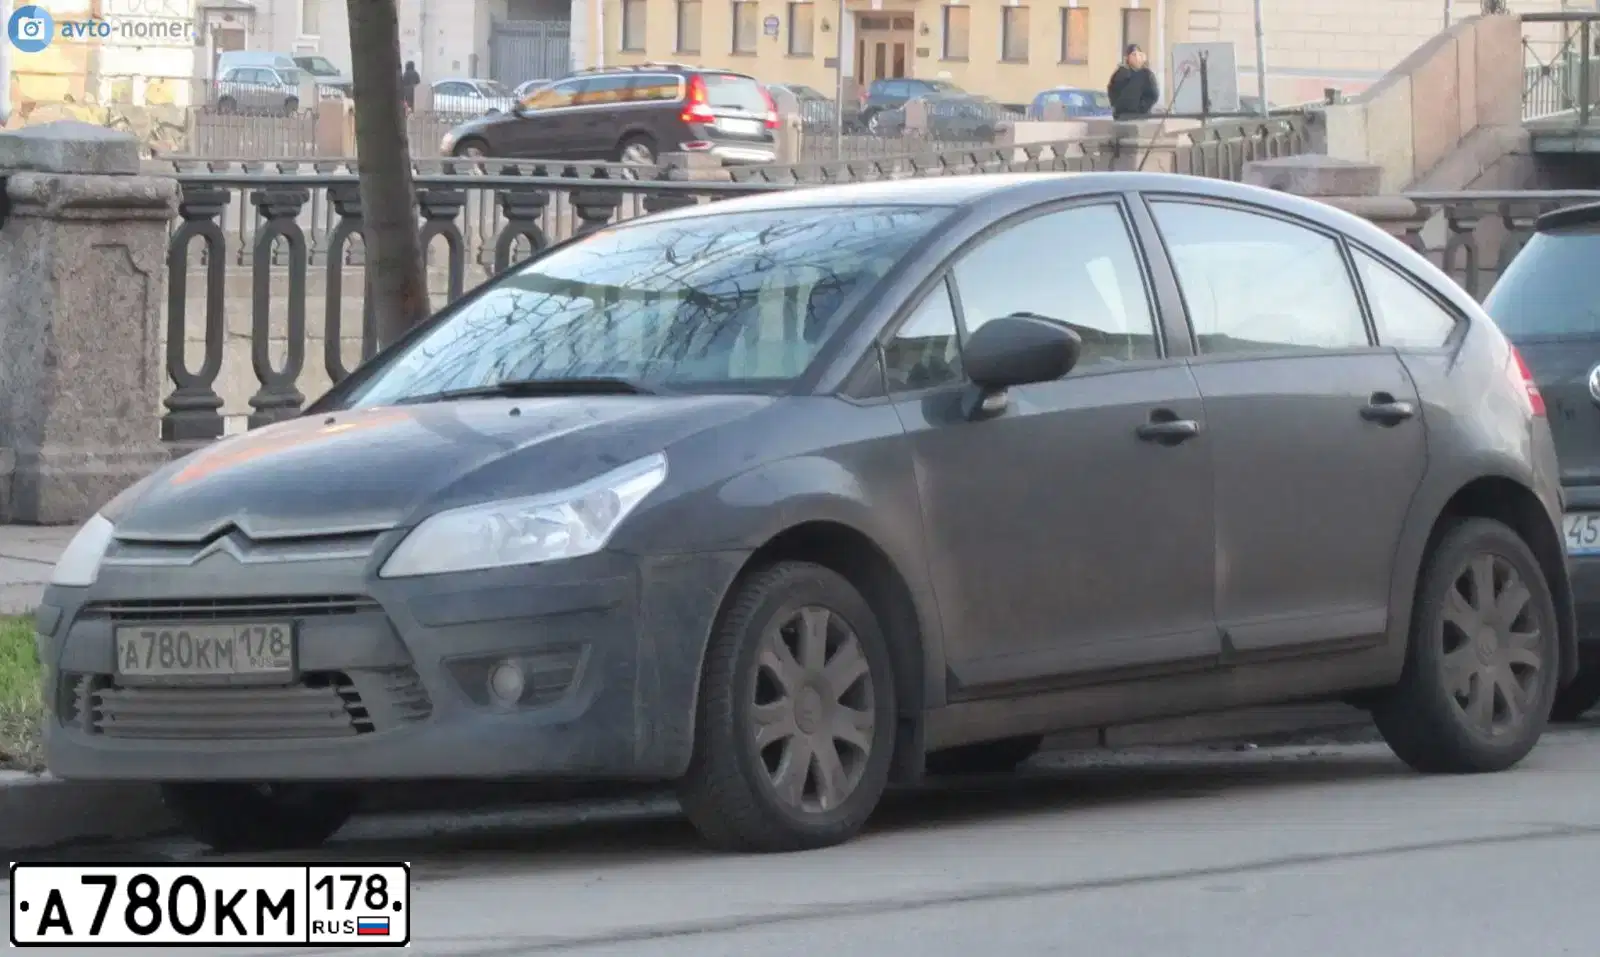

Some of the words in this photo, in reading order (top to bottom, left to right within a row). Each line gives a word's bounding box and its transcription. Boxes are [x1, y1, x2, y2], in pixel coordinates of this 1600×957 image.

[125, 630, 233, 669] A780KM
[239, 627, 285, 657] 178
[250, 656, 273, 667] RUS
